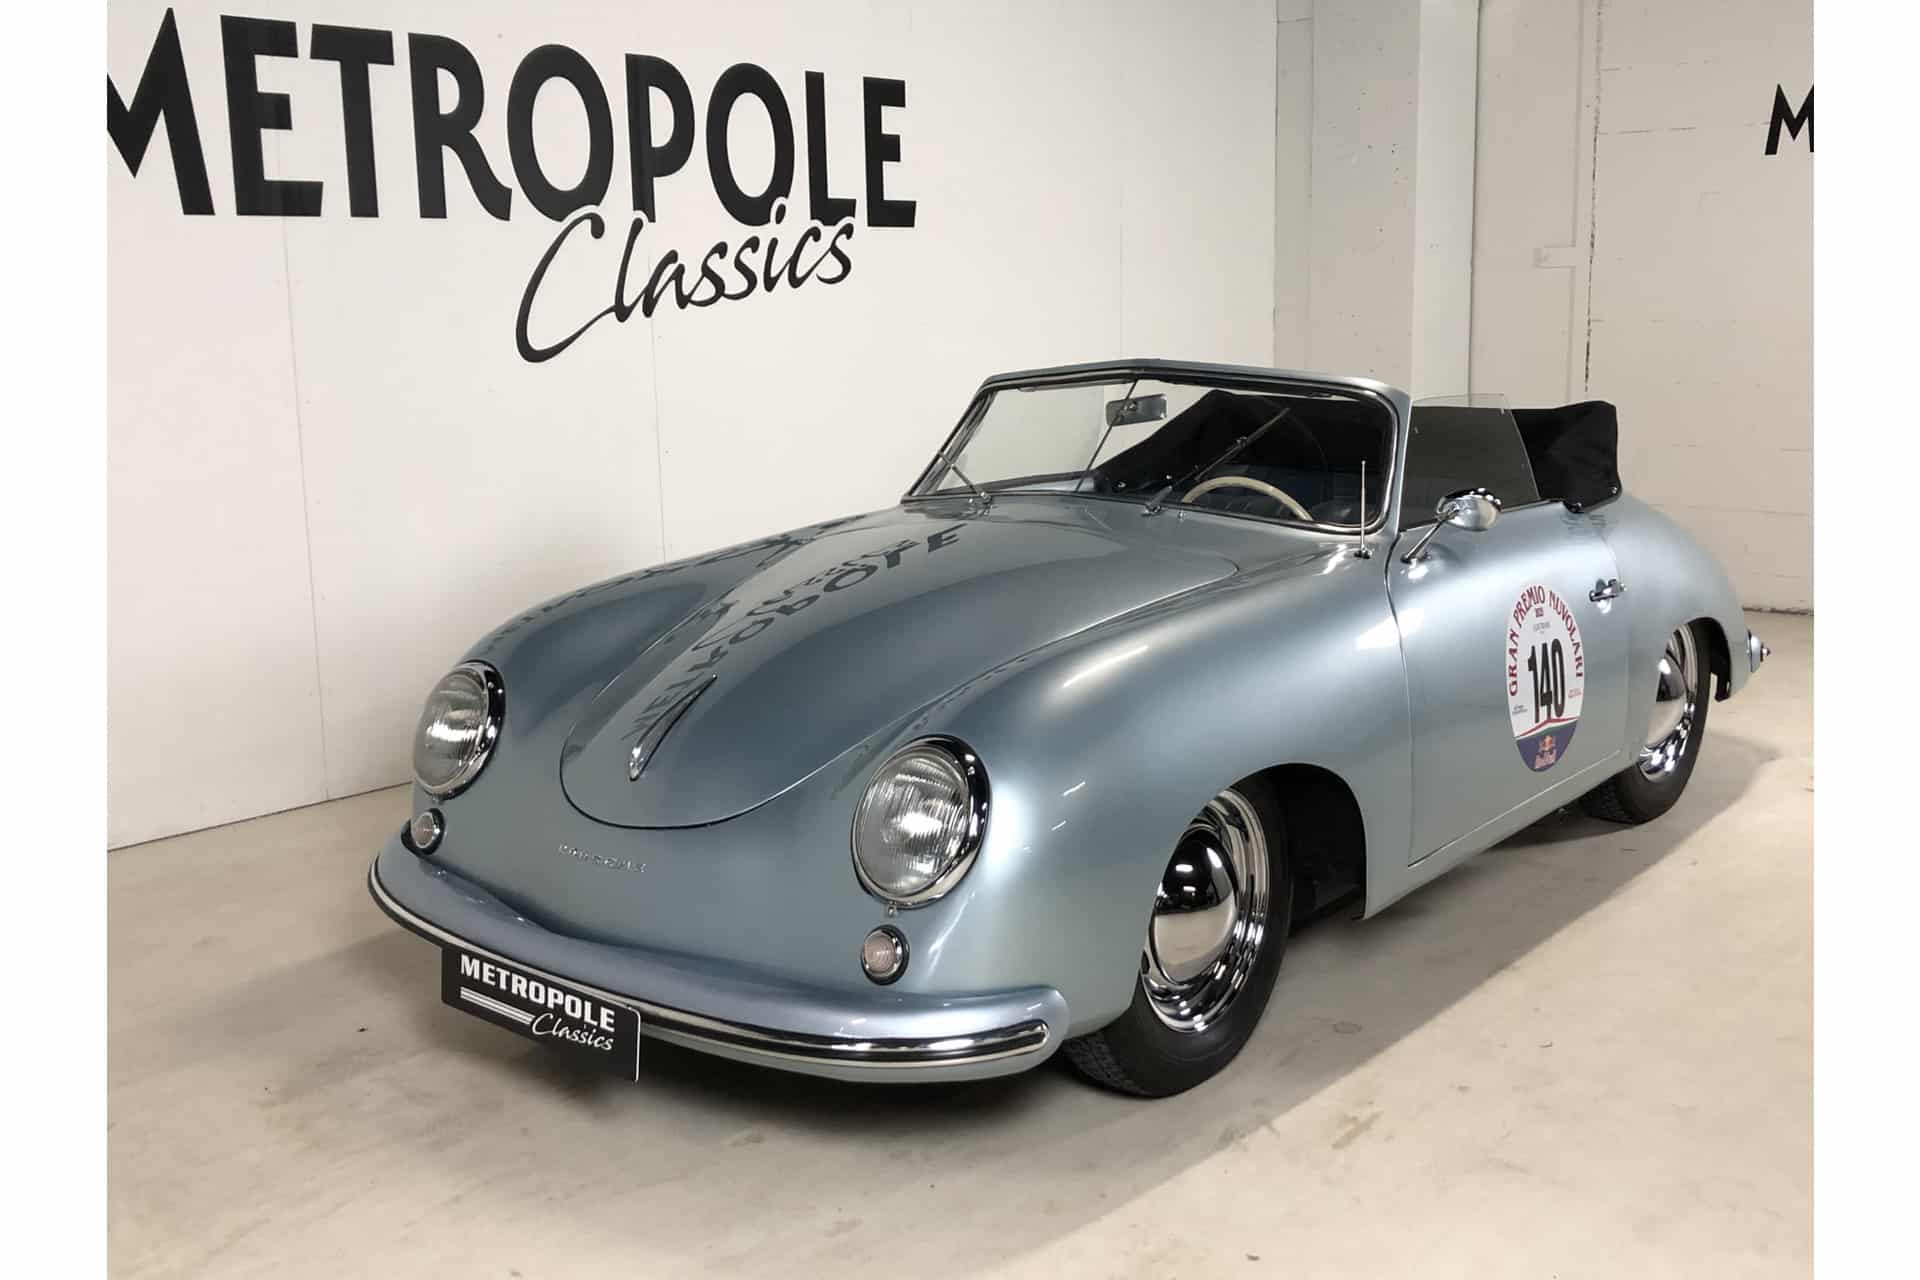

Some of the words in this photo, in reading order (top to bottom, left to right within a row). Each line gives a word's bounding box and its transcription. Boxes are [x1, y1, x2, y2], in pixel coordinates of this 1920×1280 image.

[107, 7, 917, 228] METROPOLE
[516, 196, 854, 363] Classics
[1513, 584, 1546, 629] PREMIO
[1548, 589, 1584, 678] NUVOLARI
[1507, 630, 1520, 697] GRAN
[1528, 638, 1566, 723] 140
[460, 954, 616, 1033] METROPOLE
[531, 1012, 614, 1051] Classics
